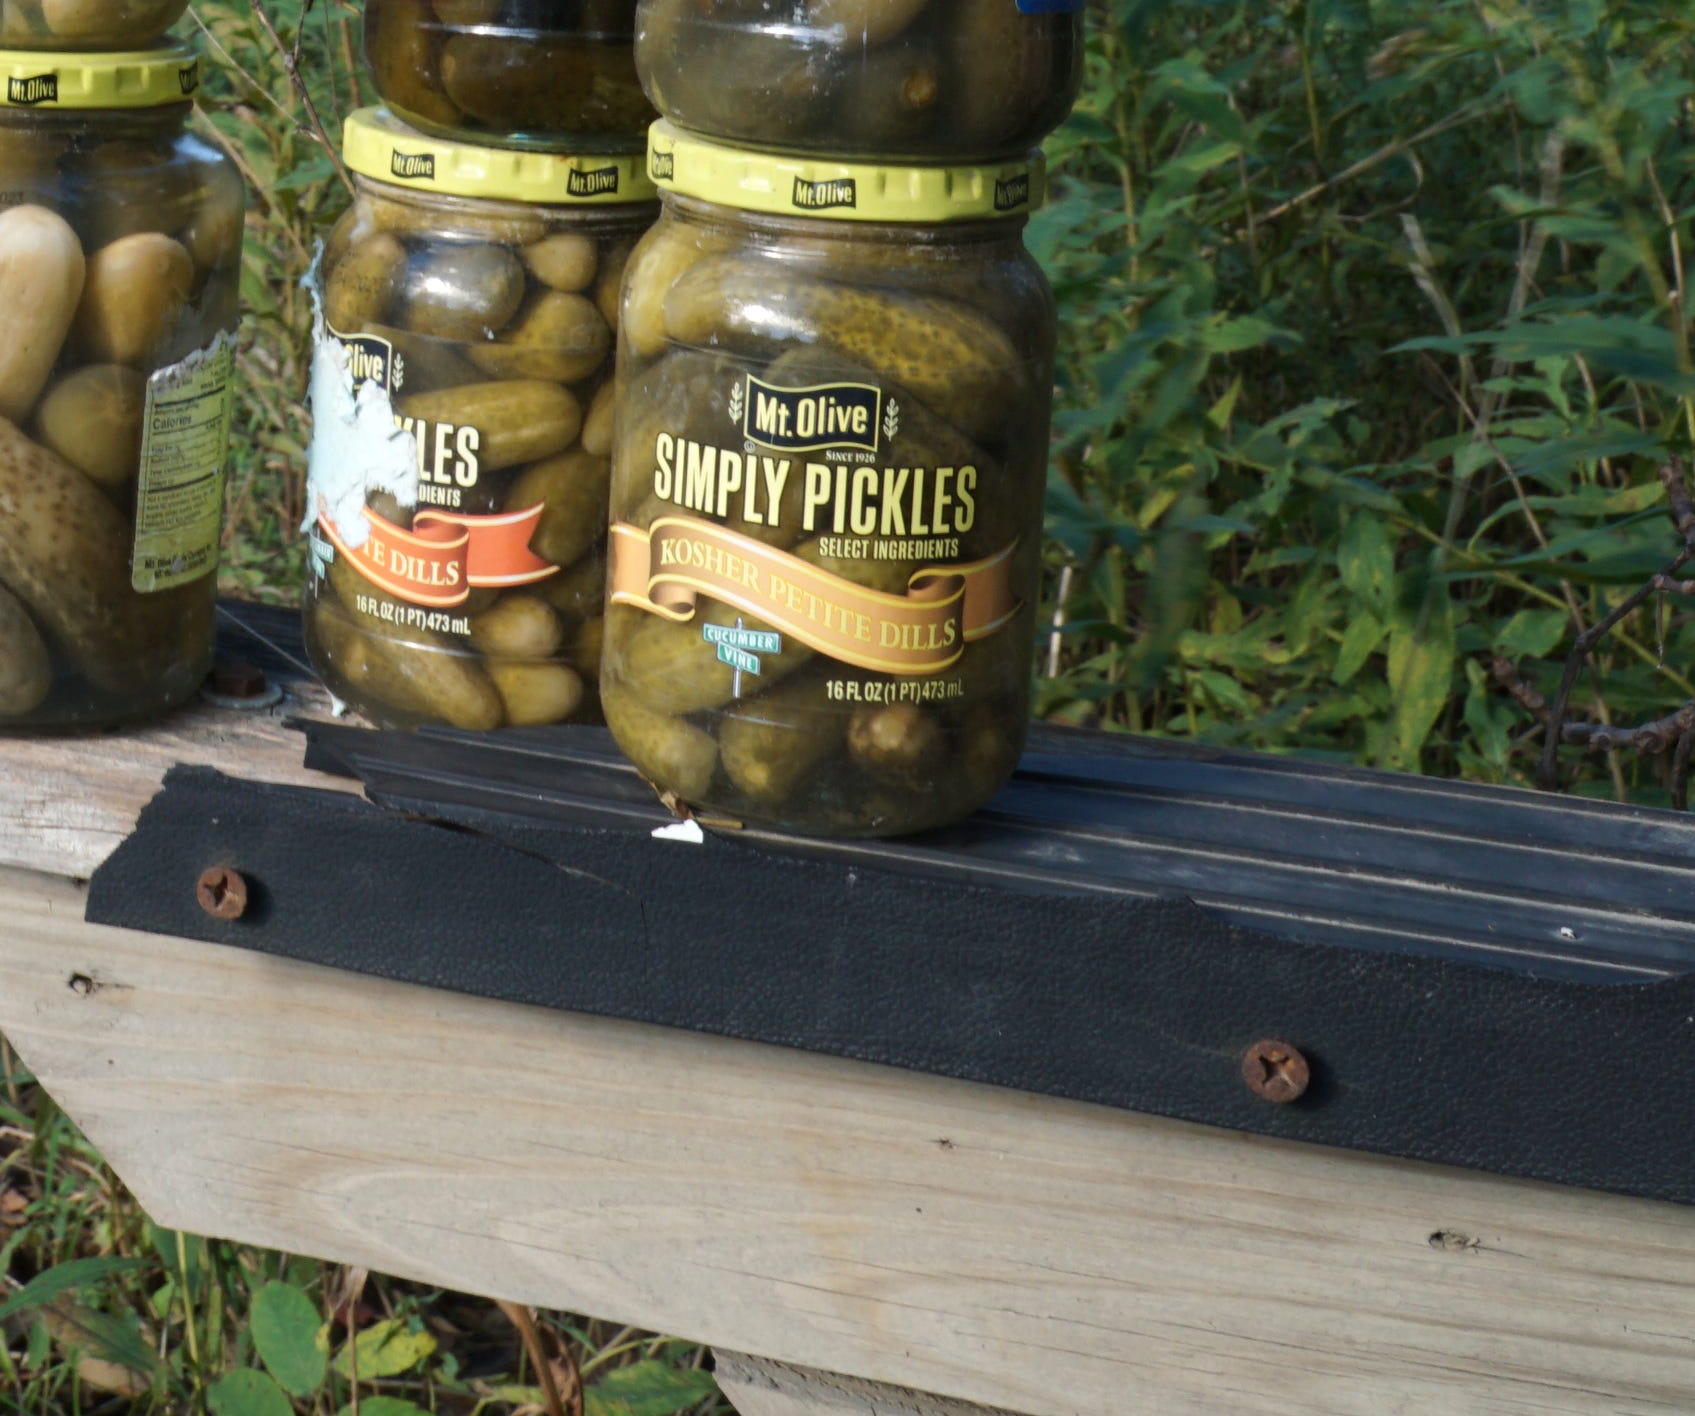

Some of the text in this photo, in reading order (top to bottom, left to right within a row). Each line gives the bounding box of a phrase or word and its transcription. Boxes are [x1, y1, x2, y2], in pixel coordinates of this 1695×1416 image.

[854, 451, 876, 465] 1926
[654, 432, 977, 536] SIMPLY PICKLES
[818, 536, 959, 561] SELECT INGREDIENTS
[389, 548, 460, 587] DILLS
[660, 538, 957, 651] KOSHER PETITE DILLS
[706, 627, 775, 650] CUCUMBER
[722, 646, 754, 670] VINE
[825, 679, 844, 701] 16
[863, 681, 883, 703] OZ
